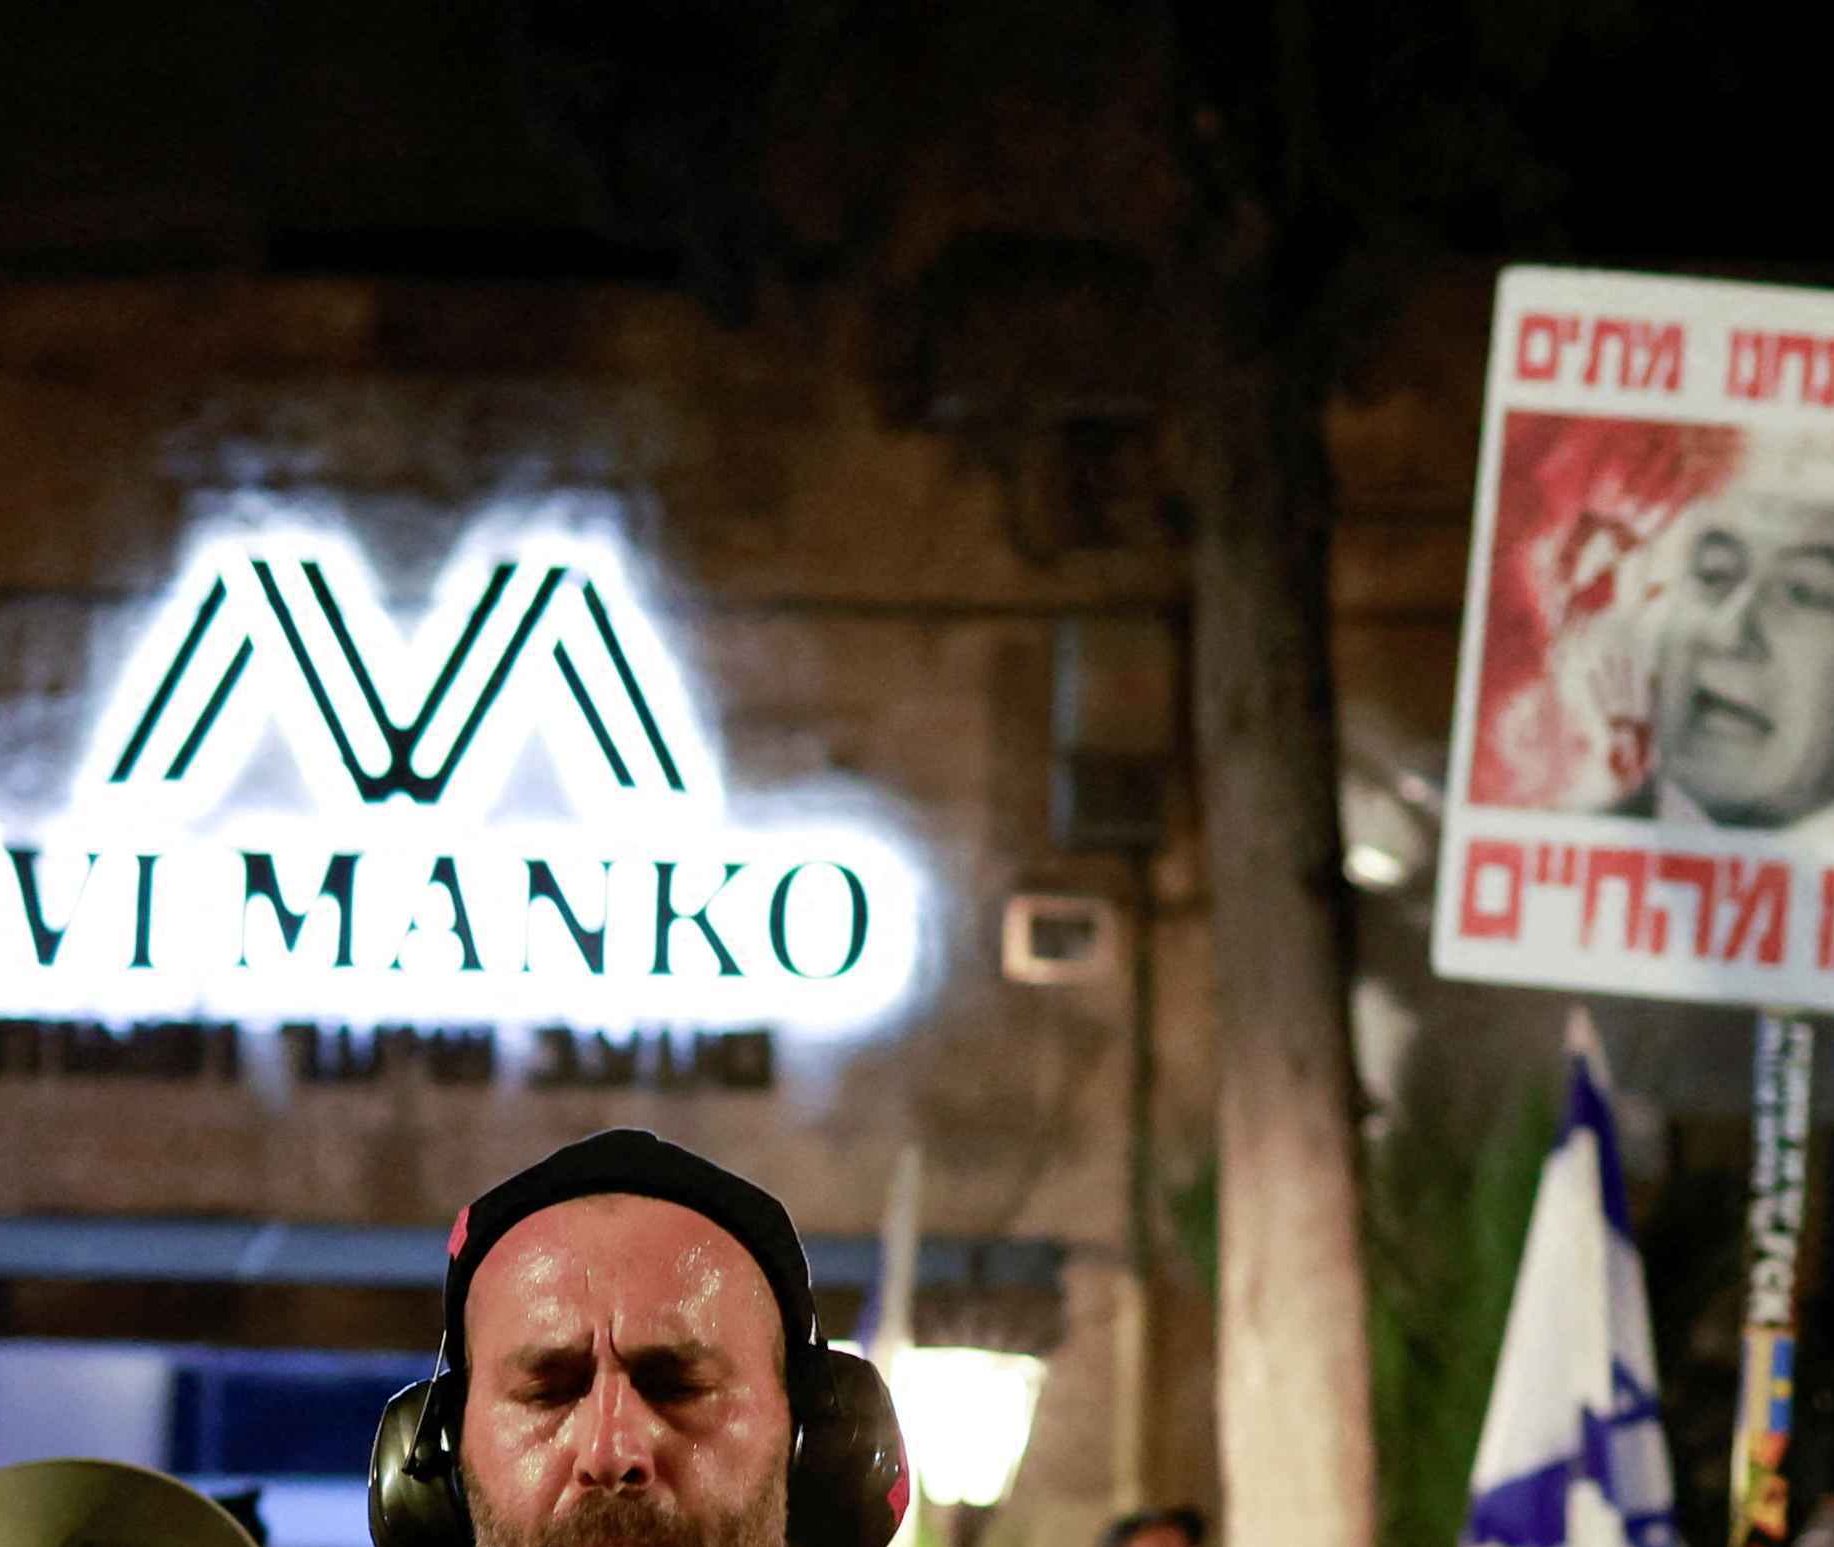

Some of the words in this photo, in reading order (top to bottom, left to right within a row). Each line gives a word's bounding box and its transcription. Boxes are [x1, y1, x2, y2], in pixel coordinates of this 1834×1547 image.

[1515, 313, 1686, 393] מתים
[241, 851, 871, 978] MANKO
[1458, 837, 1795, 967] מהחיים
